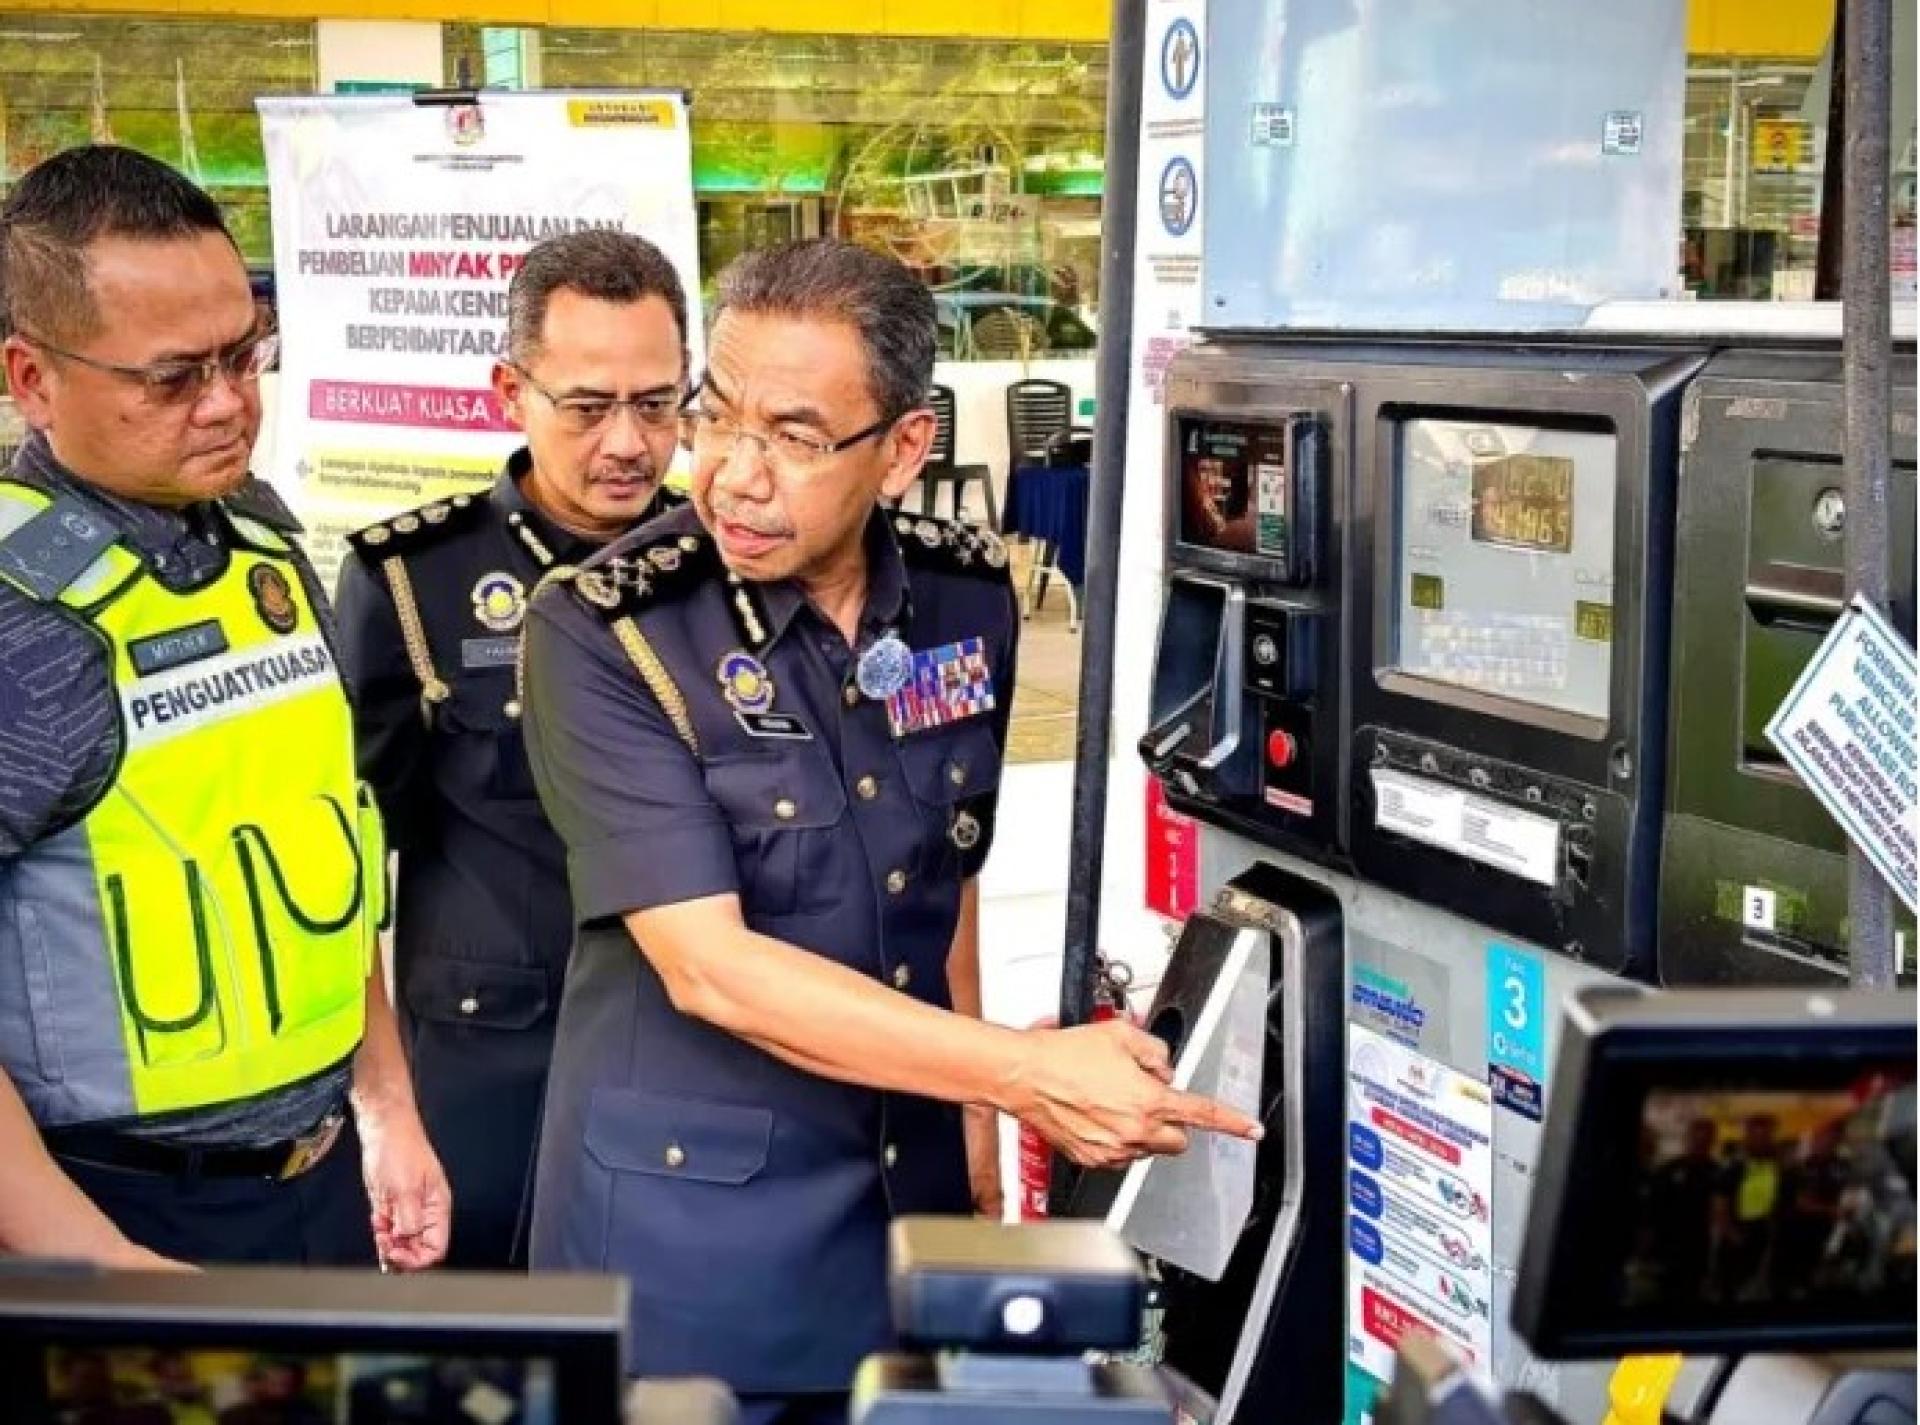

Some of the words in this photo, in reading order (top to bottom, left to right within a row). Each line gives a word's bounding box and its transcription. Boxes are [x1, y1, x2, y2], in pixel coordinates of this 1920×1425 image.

[325, 212, 438, 240] LARANGAN
[440, 214, 570, 241] PENJUALAN
[297, 249, 404, 278] PEMBELIAN
[408, 251, 493, 280] MINYAK
[368, 287, 443, 316] KEPADA
[445, 289, 511, 319] KEND
[345, 323, 512, 356] BERPENDAFTARA
[325, 386, 413, 413] BERKUAT
[419, 392, 491, 422] KUASA
[131, 645, 330, 729] PENGUATKUASA
[1853, 629, 1916, 700] FOREIGN
[1793, 728, 1846, 788] DILARANG
[1826, 691, 1900, 775] PURCHASE
[1805, 719, 1897, 825] BERPENDAFTARAN
[1842, 740, 1906, 814] KENDERAAN
[1504, 976, 1527, 1030] 3
